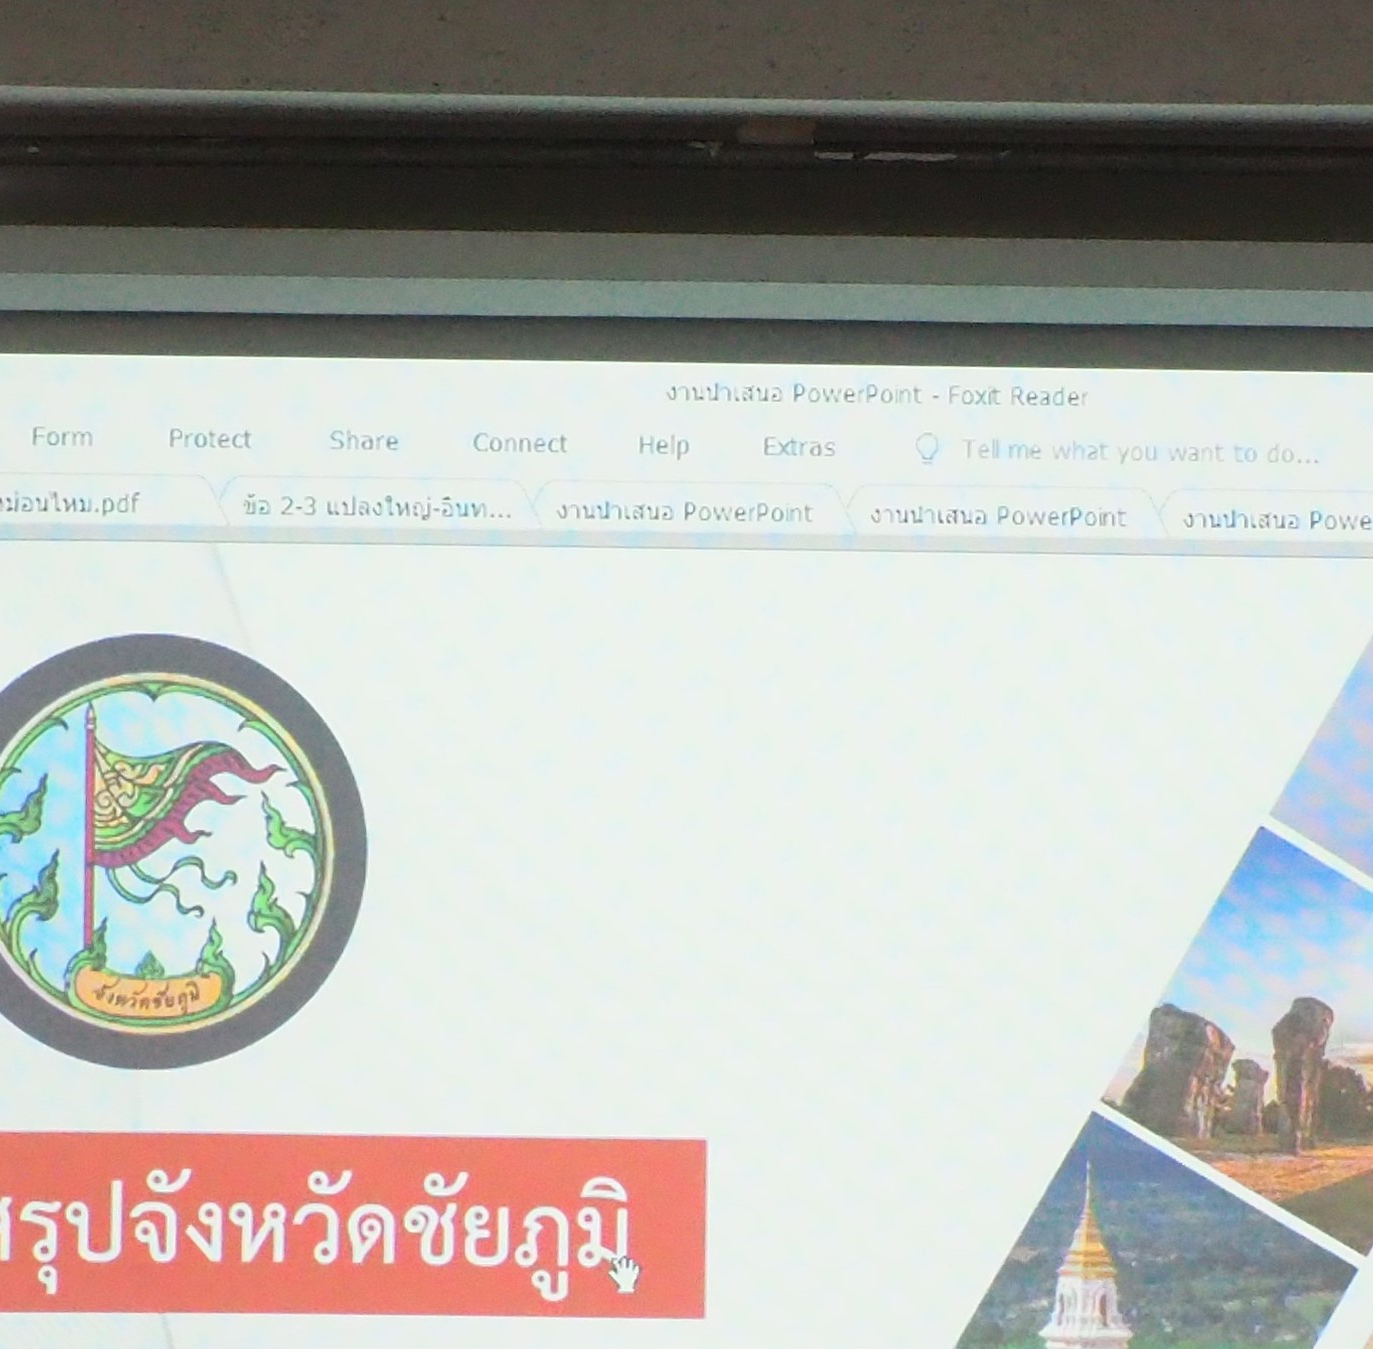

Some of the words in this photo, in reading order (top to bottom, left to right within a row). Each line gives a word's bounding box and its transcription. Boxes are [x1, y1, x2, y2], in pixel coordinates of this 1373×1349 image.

[793, 382, 921, 404] PowerPoint
[948, 385, 1000, 406] Foxit
[1011, 385, 1087, 407] Reader
[32, 426, 93, 447] Form
[169, 428, 251, 449] Protect
[330, 430, 399, 451] Share
[473, 432, 567, 454] Connect
[639, 434, 690, 461] Help
[763, 436, 836, 457] Extras
[962, 439, 1001, 459] Tell
[1008, 443, 1042, 460] me
[1053, 440, 1108, 461] what
[1118, 445, 1158, 468] you
[1168, 445, 1224, 463] want
[1233, 445, 1258, 463] to
[280, 495, 317, 516] 2-3
[684, 501, 812, 523] PowerPoint
[997, 505, 1126, 527] PowerPoint
